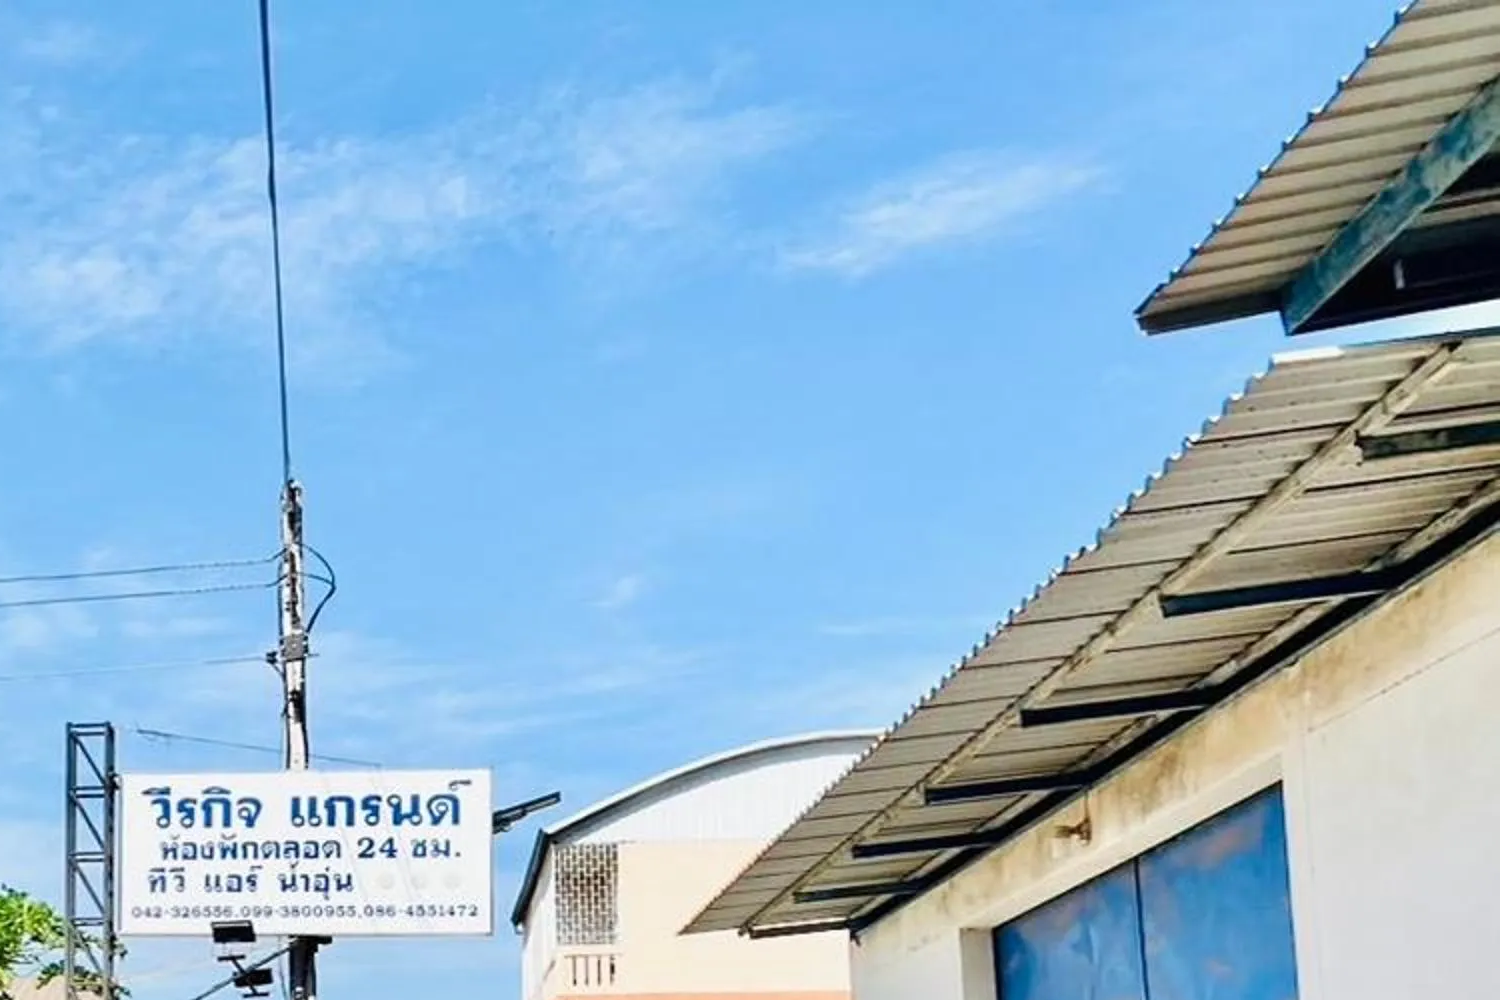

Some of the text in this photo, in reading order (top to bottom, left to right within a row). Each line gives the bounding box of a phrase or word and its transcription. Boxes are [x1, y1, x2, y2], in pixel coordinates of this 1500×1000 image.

[141, 779, 472, 829] วีรกิจ แกรนด์
[160, 832, 461, 860] ห้องพักตลอด 24 ชม.
[148, 867, 185, 893] ทีวี
[204, 865, 263, 893] แอร์
